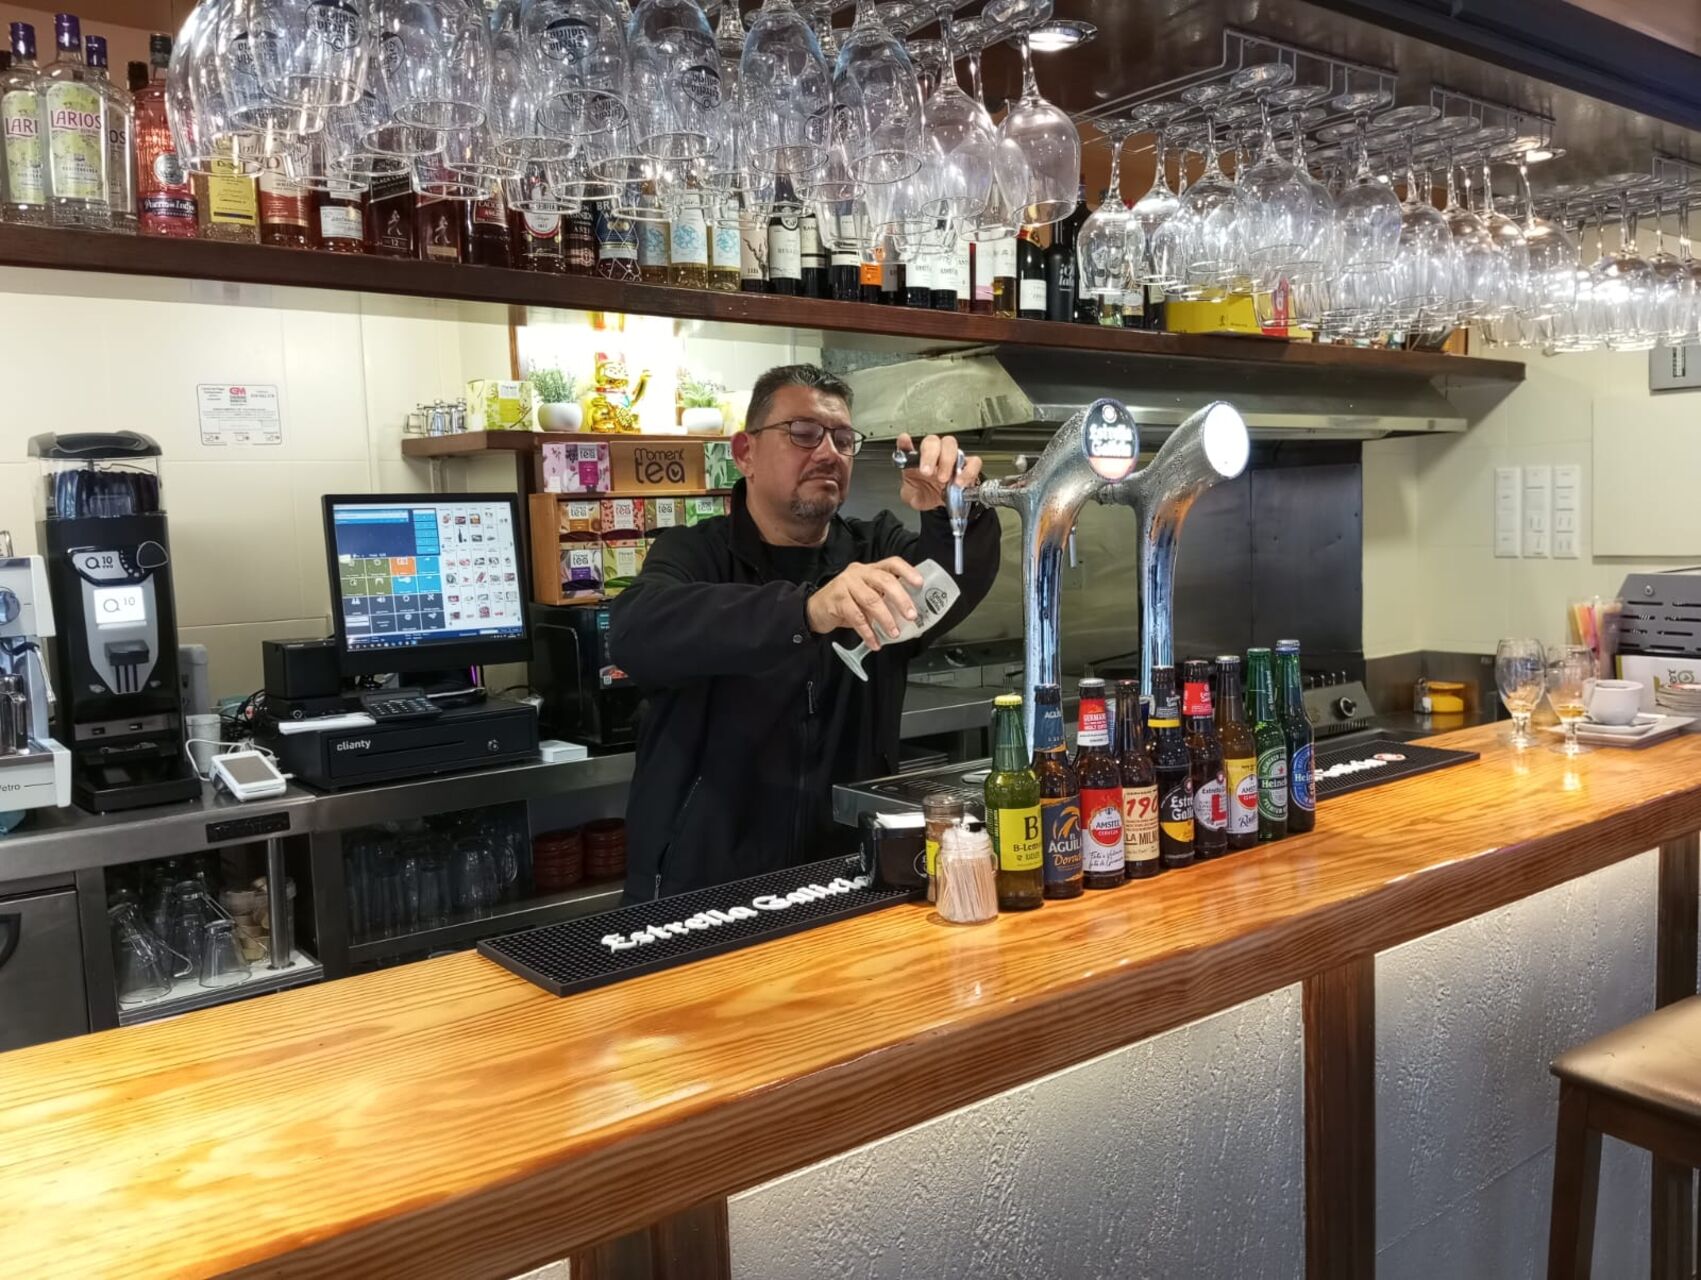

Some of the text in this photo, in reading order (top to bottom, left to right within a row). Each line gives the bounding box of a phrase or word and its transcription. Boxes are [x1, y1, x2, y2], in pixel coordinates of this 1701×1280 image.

[550, 26, 587, 39] Galicia
[51, 109, 101, 129] LARIOS
[635, 460, 686, 485] tea
[102, 556, 113, 565] 10
[123, 596, 136, 607] 10
[1024, 815, 1039, 841] B
[1126, 833, 1137, 842] LA
[602, 876, 869, 954] Estrella Galicia
